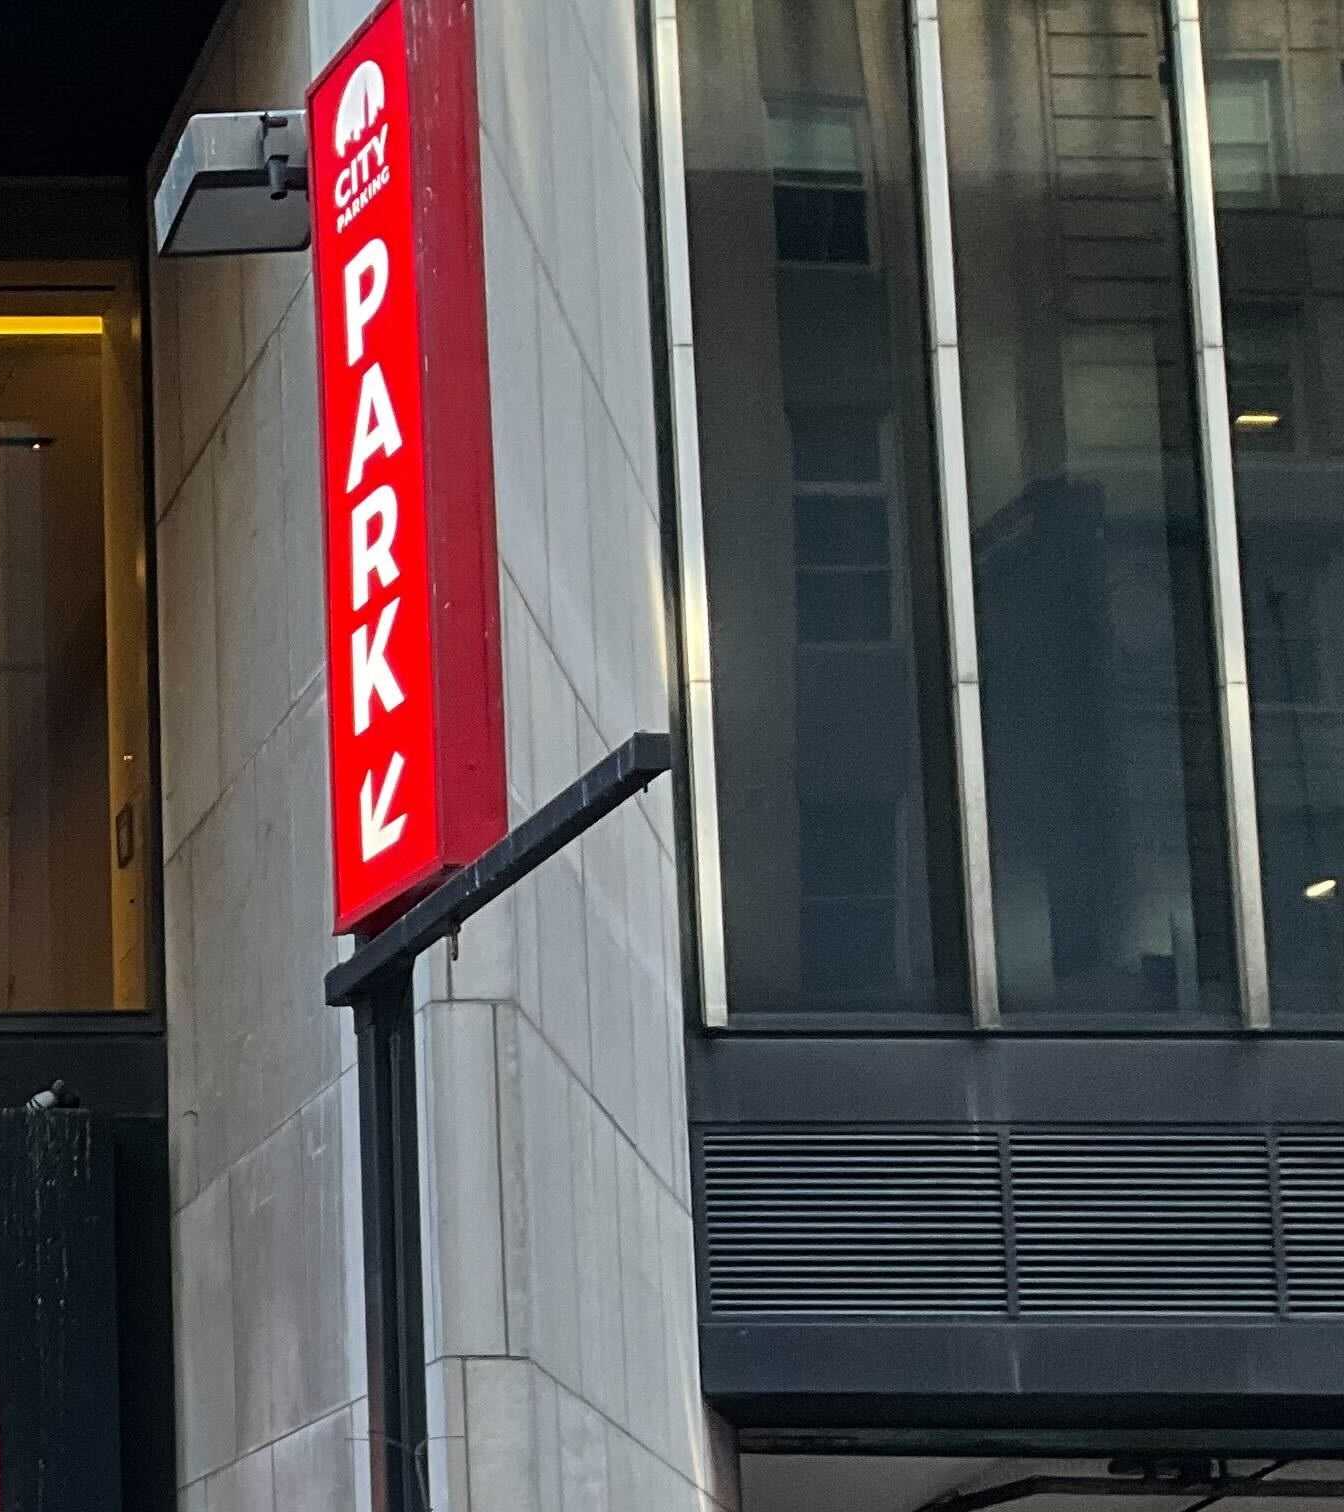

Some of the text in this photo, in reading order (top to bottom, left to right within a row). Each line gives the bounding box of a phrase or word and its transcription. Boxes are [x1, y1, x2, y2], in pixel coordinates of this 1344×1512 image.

[334, 121, 389, 209] CITY
[336, 165, 391, 234] PARKING
[344, 238, 405, 736] PARK
